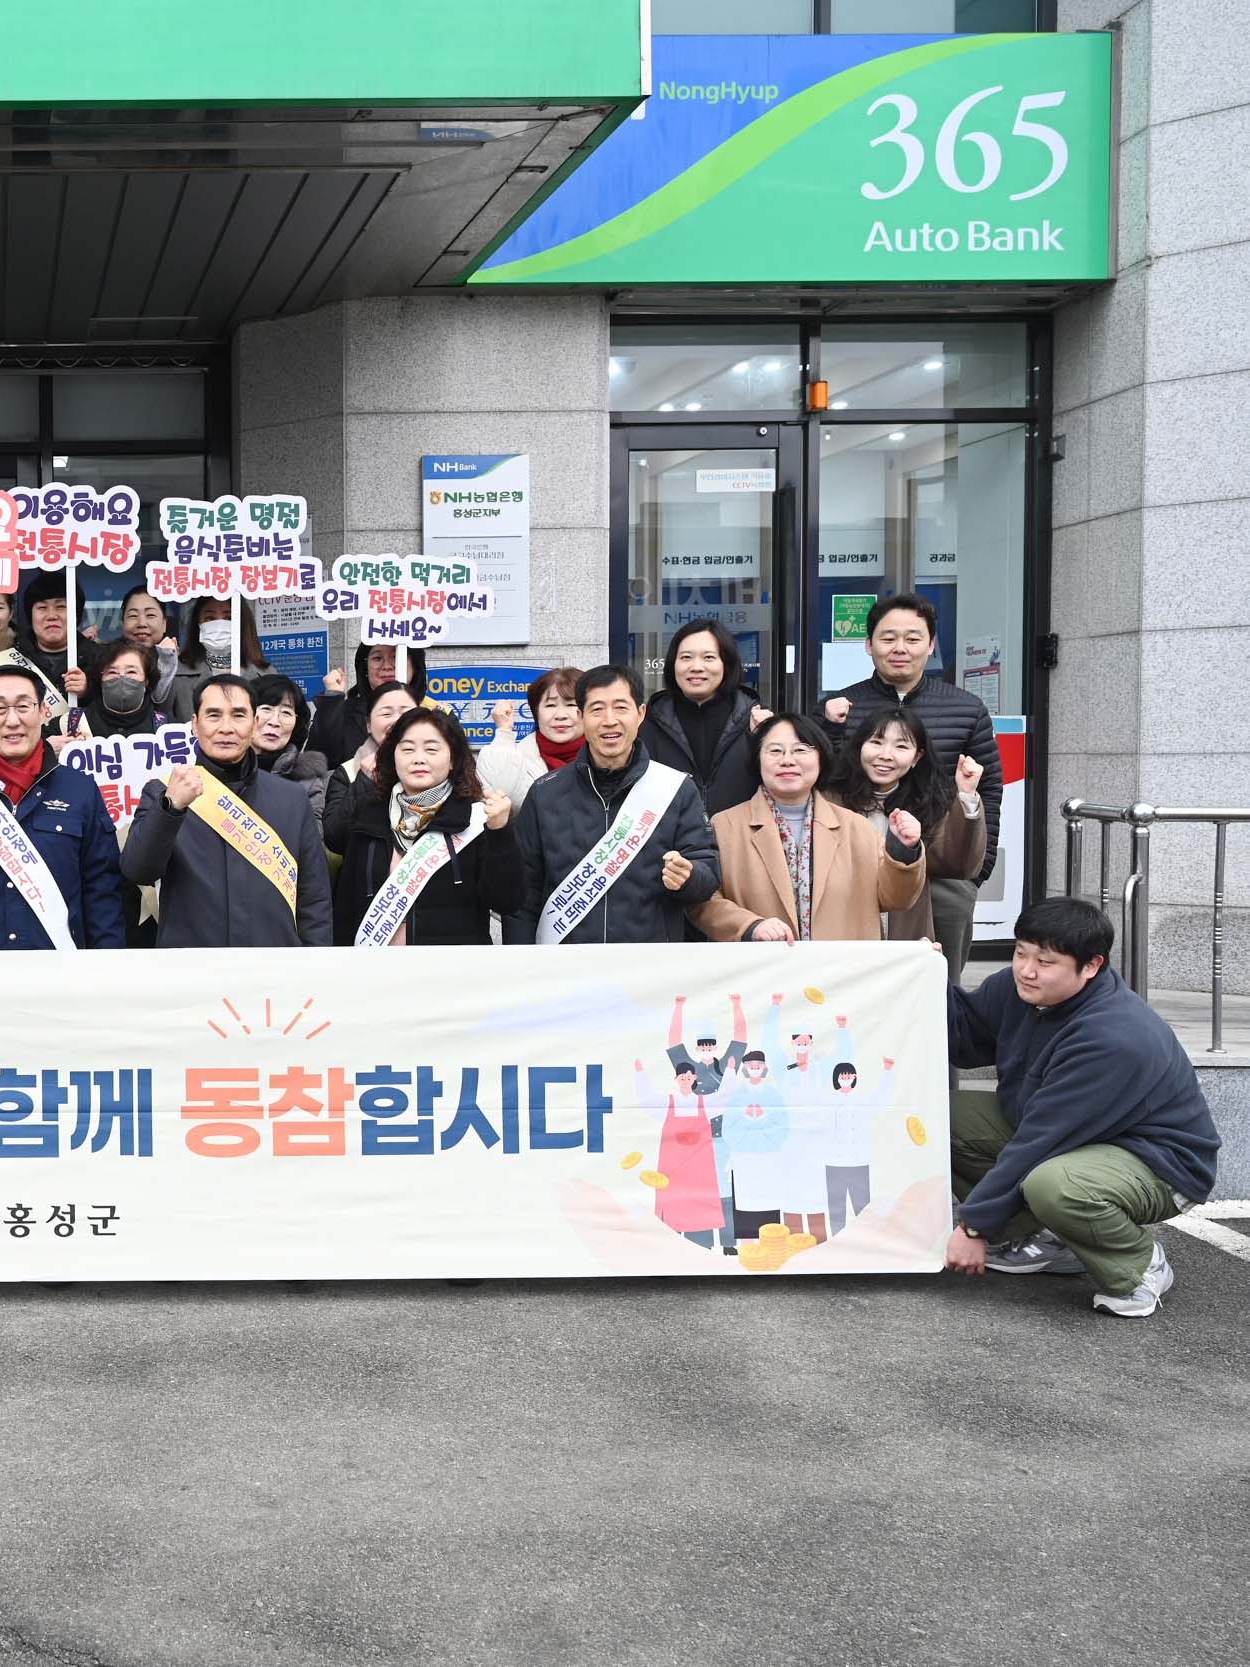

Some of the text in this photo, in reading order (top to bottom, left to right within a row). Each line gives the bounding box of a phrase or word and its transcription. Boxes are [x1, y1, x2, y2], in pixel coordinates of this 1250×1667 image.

[660, 81, 779, 104] NongHyup
[860, 86, 1068, 201] 365
[864, 221, 1064, 253] Auto Bank
[434, 462, 477, 473] NH Bank
[12, 489, 133, 526] 이용해요
[444, 490, 524, 504] NH농협은행
[453, 507, 501, 519] 홍성군지부
[167, 501, 300, 533] 즐거운 명절
[174, 532, 295, 564] 음식준비는
[152, 562, 317, 595] 전통시장 장보기로
[340, 561, 470, 587] 안전한 먹거리
[322, 588, 488, 615] 우리 전통시장에서
[368, 616, 443, 640] 사세요~
[851, 623, 866, 633] AE
[644, 658, 665, 670] 365
[428, 678, 485, 698] oney
[133, 731, 199, 770] 가득
[216, 794, 297, 882] 합리적인 소비활
[220, 818, 273, 866] 물가안정
[396, 834, 439, 886] 전통시장
[547, 814, 634, 915] 전통시장 장보기로!
[552, 810, 657, 935] 즐거운 명절 음식준비는
[405, 866, 428, 896] 명절
[370, 896, 408, 946] 음식준비
[180, 1064, 613, 1158] 동참합시다
